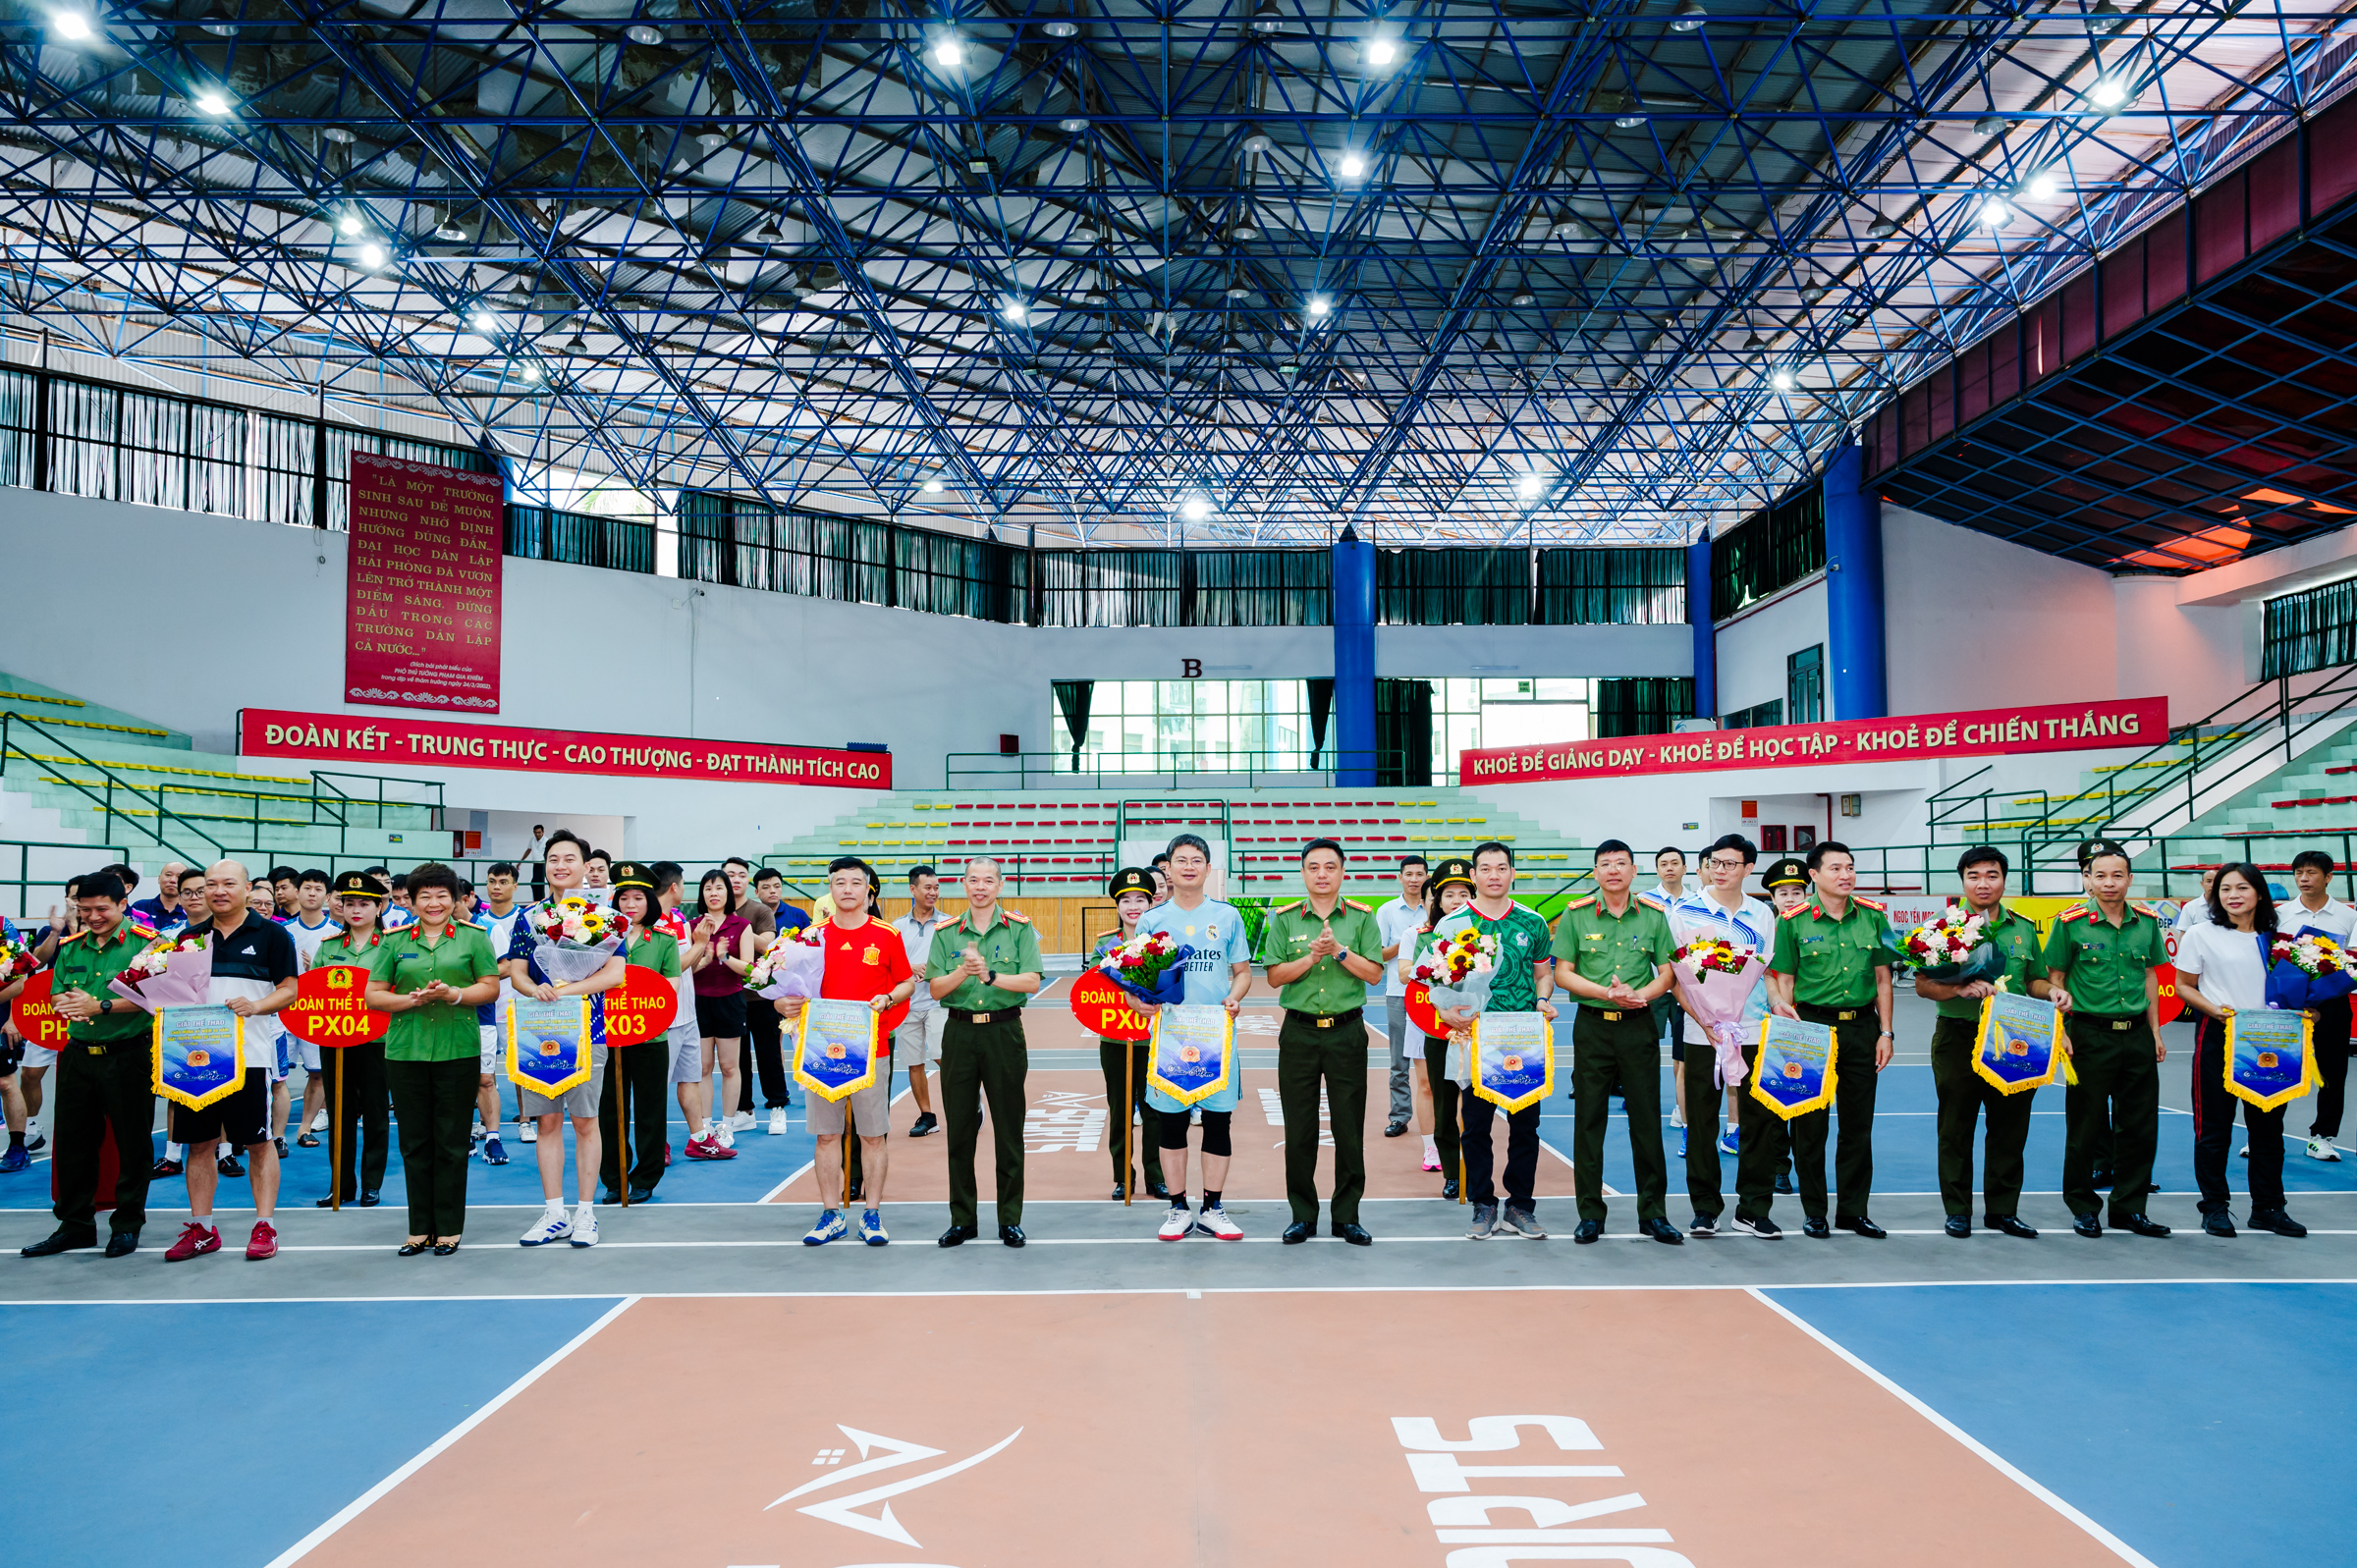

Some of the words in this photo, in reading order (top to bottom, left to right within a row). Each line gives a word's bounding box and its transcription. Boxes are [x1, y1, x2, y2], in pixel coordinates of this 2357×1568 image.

[407, 480, 434, 494] MỘT
[444, 487, 494, 503] TRƯỜNG
[358, 490, 392, 503] SINH
[398, 496, 423, 508] SAU
[454, 506, 494, 520] MUỘN,
[358, 507, 409, 522] NHƯNG
[420, 515, 449, 527] NHỜ
[461, 522, 494, 535] ĐỊNH
[358, 523, 405, 538] HƯỚNG
[414, 530, 451, 544] ĐÚNG
[357, 540, 382, 552] ĐẠI
[394, 545, 420, 557] HỌC
[431, 549, 459, 562] DÂN
[469, 555, 493, 568] LẬP
[357, 554, 382, 568] HẢI
[387, 560, 432, 573] PHÒNG
[436, 567, 454, 577] ĐÃ
[459, 570, 493, 582] VƯƠN
[356, 571, 383, 584] LÊN
[387, 575, 413, 588] TRỞ
[417, 580, 462, 594] THÀNH
[466, 586, 493, 599] MỘT
[356, 586, 393, 602] ĐIỂM
[456, 601, 492, 614] ĐỨNG
[356, 603, 388, 618] ĐẦU
[402, 611, 453, 625] TRONG
[465, 618, 492, 629] CÁC
[356, 623, 413, 637] TRƯỜNG
[426, 629, 455, 641] DÂN
[466, 634, 491, 646] LẬP
[356, 638, 372, 651] CẢ
[1181, 659, 1202, 677] B
[265, 723, 339, 748] ĐOÀN
[347, 726, 390, 750] KẾT
[408, 733, 484, 757] TRUNG
[489, 738, 547, 765] THỰC
[564, 744, 606, 764] CAO
[610, 746, 691, 772] THƯỢNG
[706, 752, 741, 776] ĐẠT
[744, 754, 803, 776] THÀNH
[807, 756, 844, 778] TÍCH
[848, 762, 880, 780] CAO
[1473, 752, 1517, 776] KHOẺ
[1521, 750, 1544, 773] ĐỂ
[1548, 747, 1604, 771] GIẢNG
[1609, 748, 1644, 771] DẠY
[1660, 738, 1712, 763] KHOẺ
[1717, 735, 1744, 760] ĐỂ
[1750, 737, 1793, 762] HỌC
[1797, 732, 1837, 759] TẬP
[1857, 724, 1919, 751] KHOẺ
[1925, 720, 1957, 747] ĐỂ
[1963, 715, 2039, 744] CHIẾN
[2044, 710, 2139, 739] THẮNG
[1184, 962, 1213, 971] BETTER
[328, 992, 353, 1010] THỂ
[605, 991, 628, 1010] THỂ
[630, 997, 666, 1009] THAO
[1080, 988, 1115, 1003] ĐOÀN
[23, 1000, 55, 1015] ĐOÀN
[308, 1015, 370, 1036] PX04
